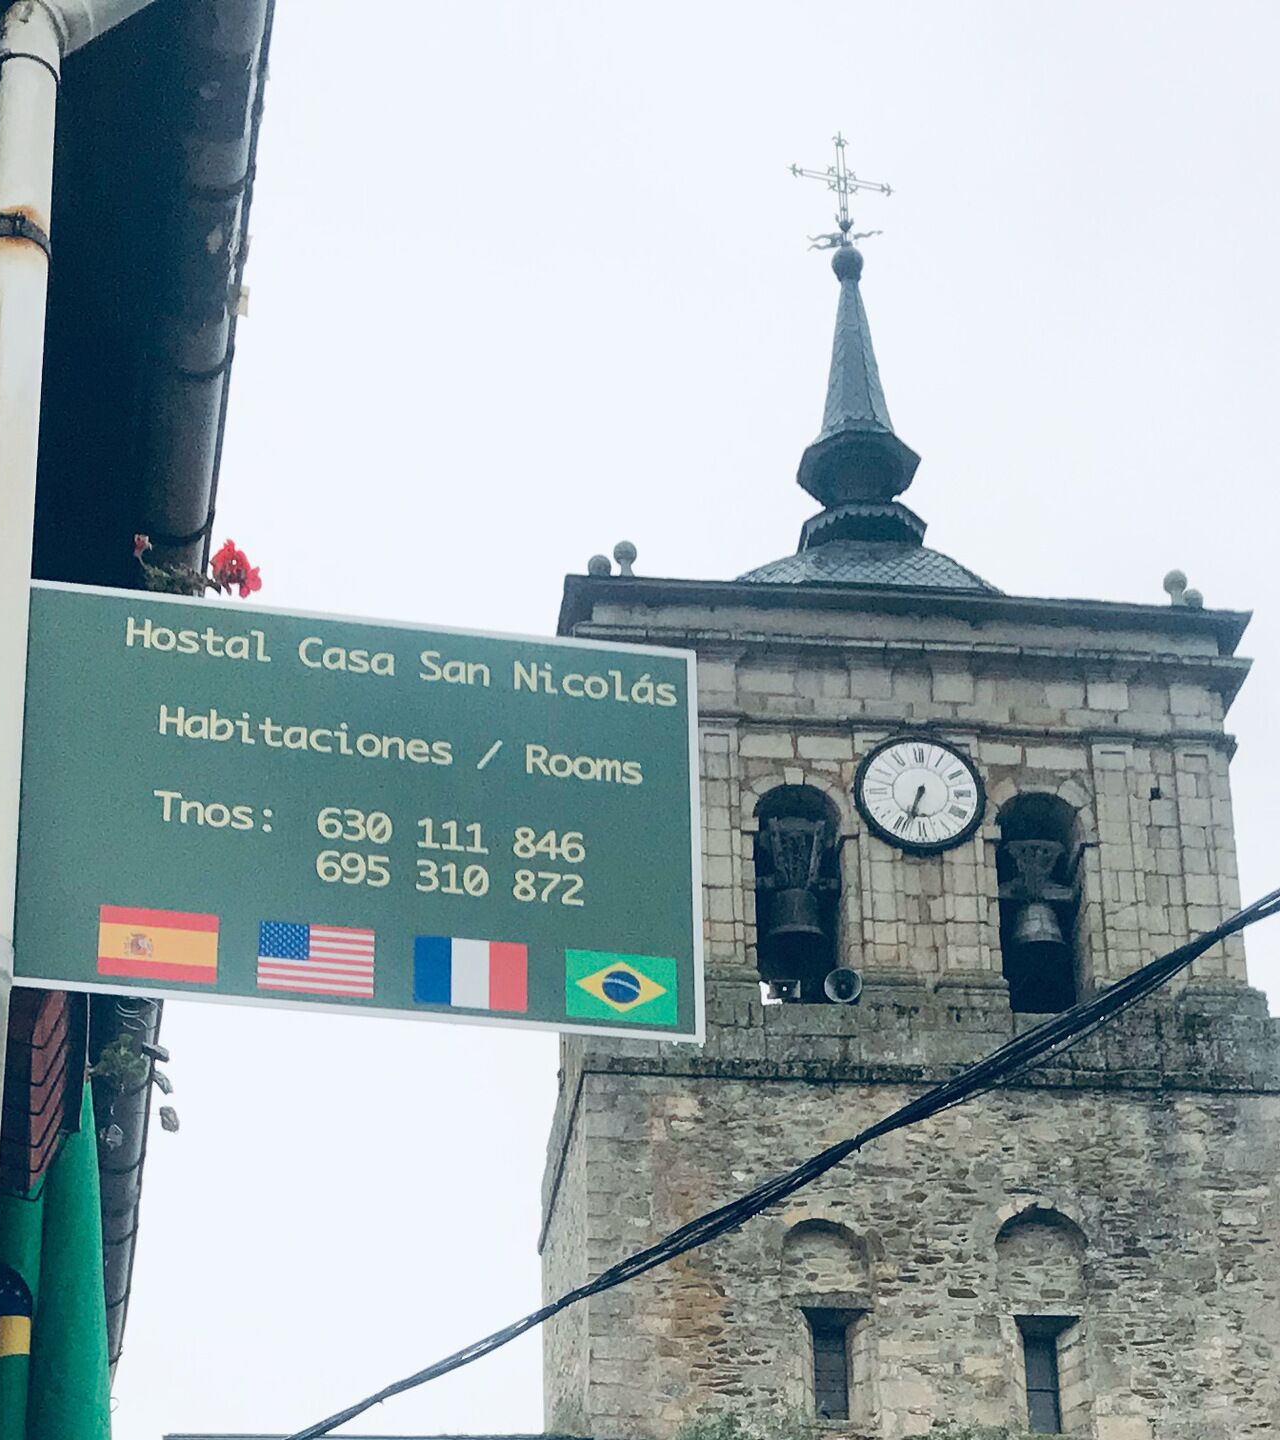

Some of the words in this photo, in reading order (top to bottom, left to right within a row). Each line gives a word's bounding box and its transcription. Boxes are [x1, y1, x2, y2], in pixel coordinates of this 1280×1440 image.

[127, 616, 271, 661] Hostal
[299, 638, 395, 677] Casa
[420, 650, 490, 687] San
[514, 660, 677, 706] Nicolás
[159, 704, 454, 766] Habitaciones
[526, 743, 643, 785] Rooms
[154, 789, 273, 833] Tnos:
[317, 807, 393, 844] 630
[417, 818, 489, 854] 111
[513, 827, 586, 863] 846
[316, 850, 390, 887] 695
[415, 859, 489, 898] 310
[513, 869, 584, 906] 872
